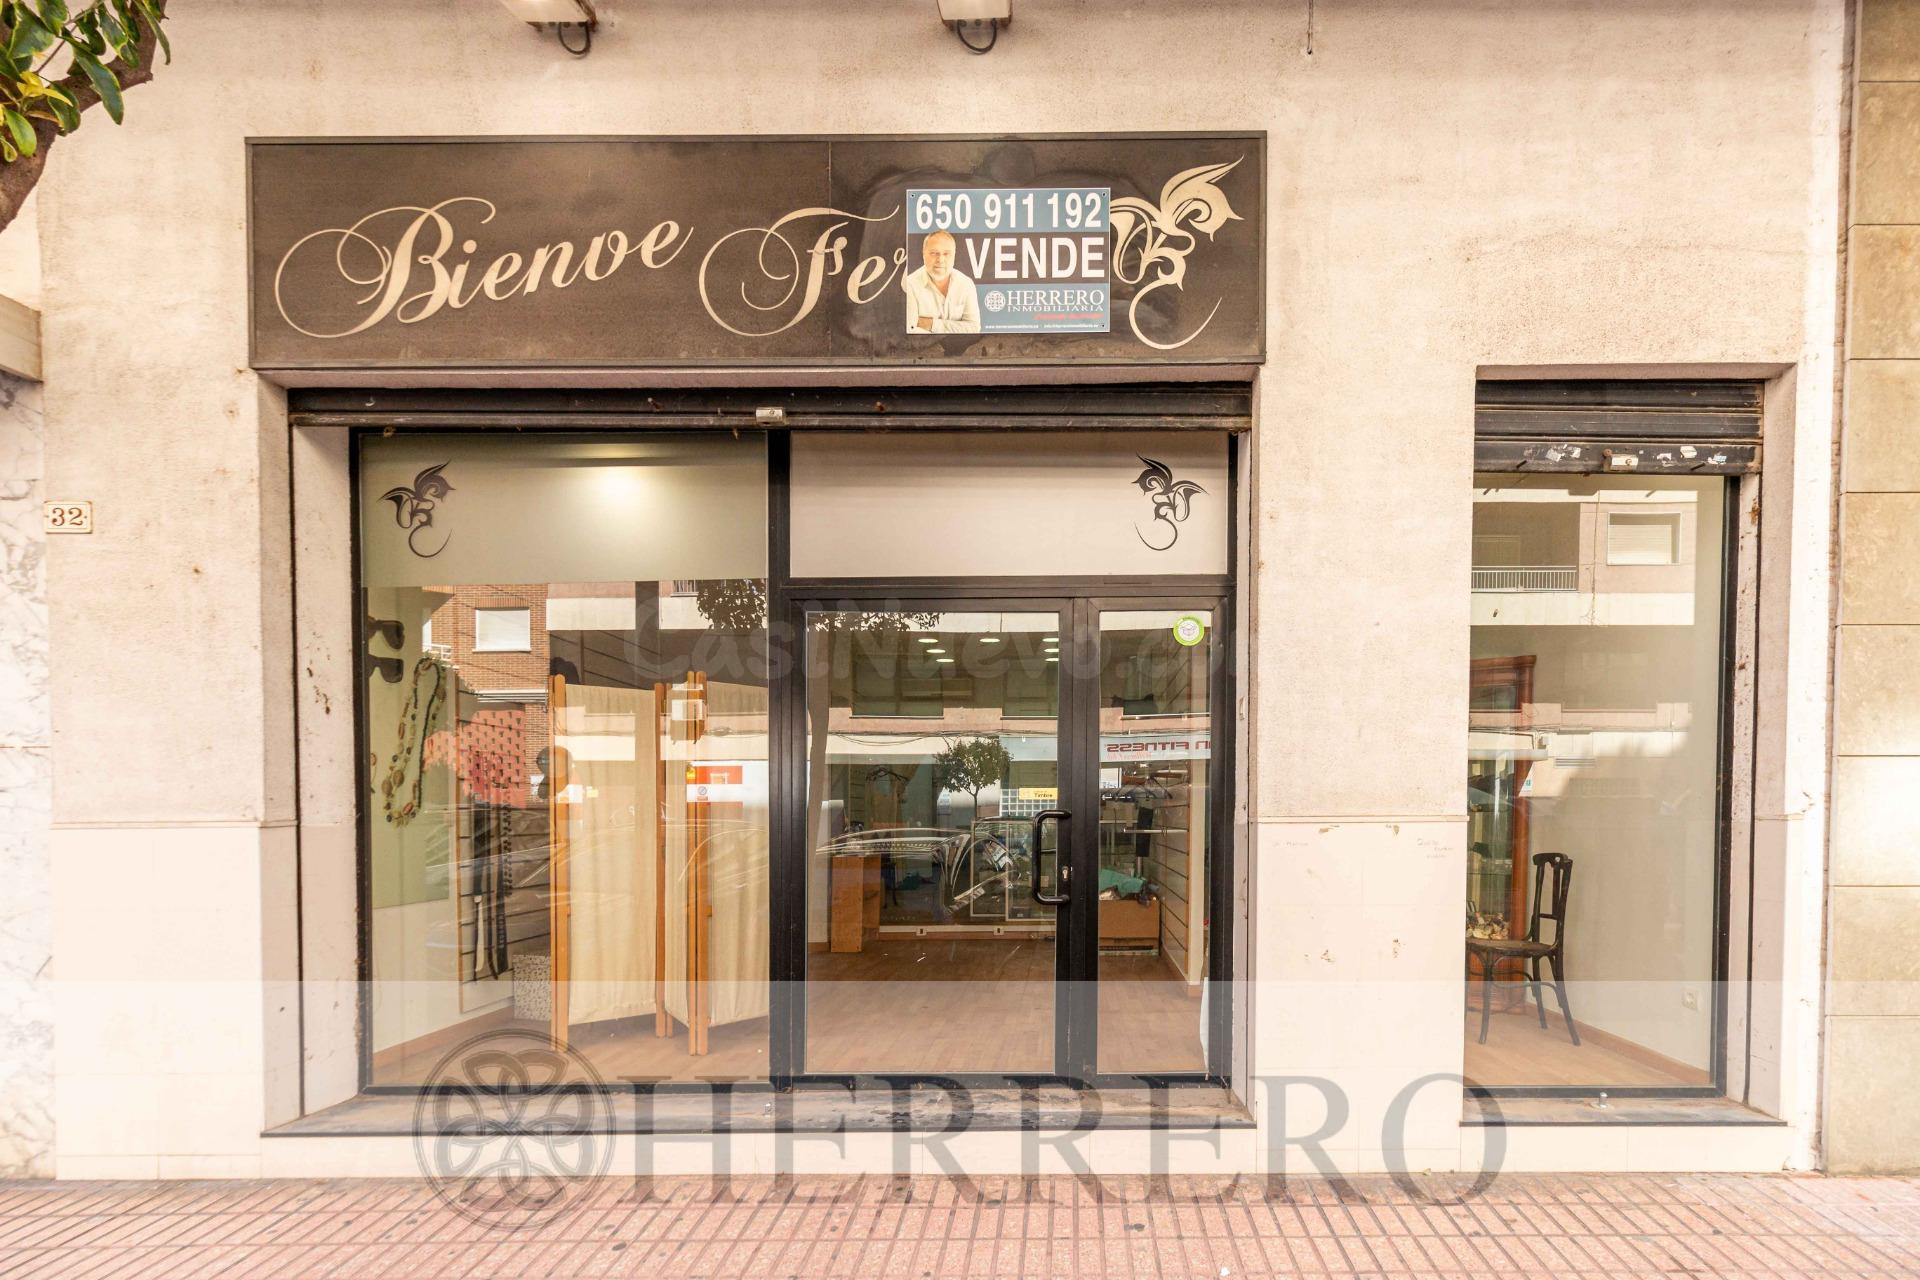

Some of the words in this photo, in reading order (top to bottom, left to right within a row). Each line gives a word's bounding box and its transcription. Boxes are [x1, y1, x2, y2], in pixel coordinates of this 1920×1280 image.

[916, 193, 972, 230] 650
[984, 193, 1034, 229] 911
[1047, 192, 1102, 229] 192
[274, 196, 694, 339] Bienve
[965, 237, 1105, 279] VENDE
[1006, 289, 1105, 306] HERRERO
[1007, 304, 1104, 313] INMOBILIARIA
[51, 507, 84, 527] 32
